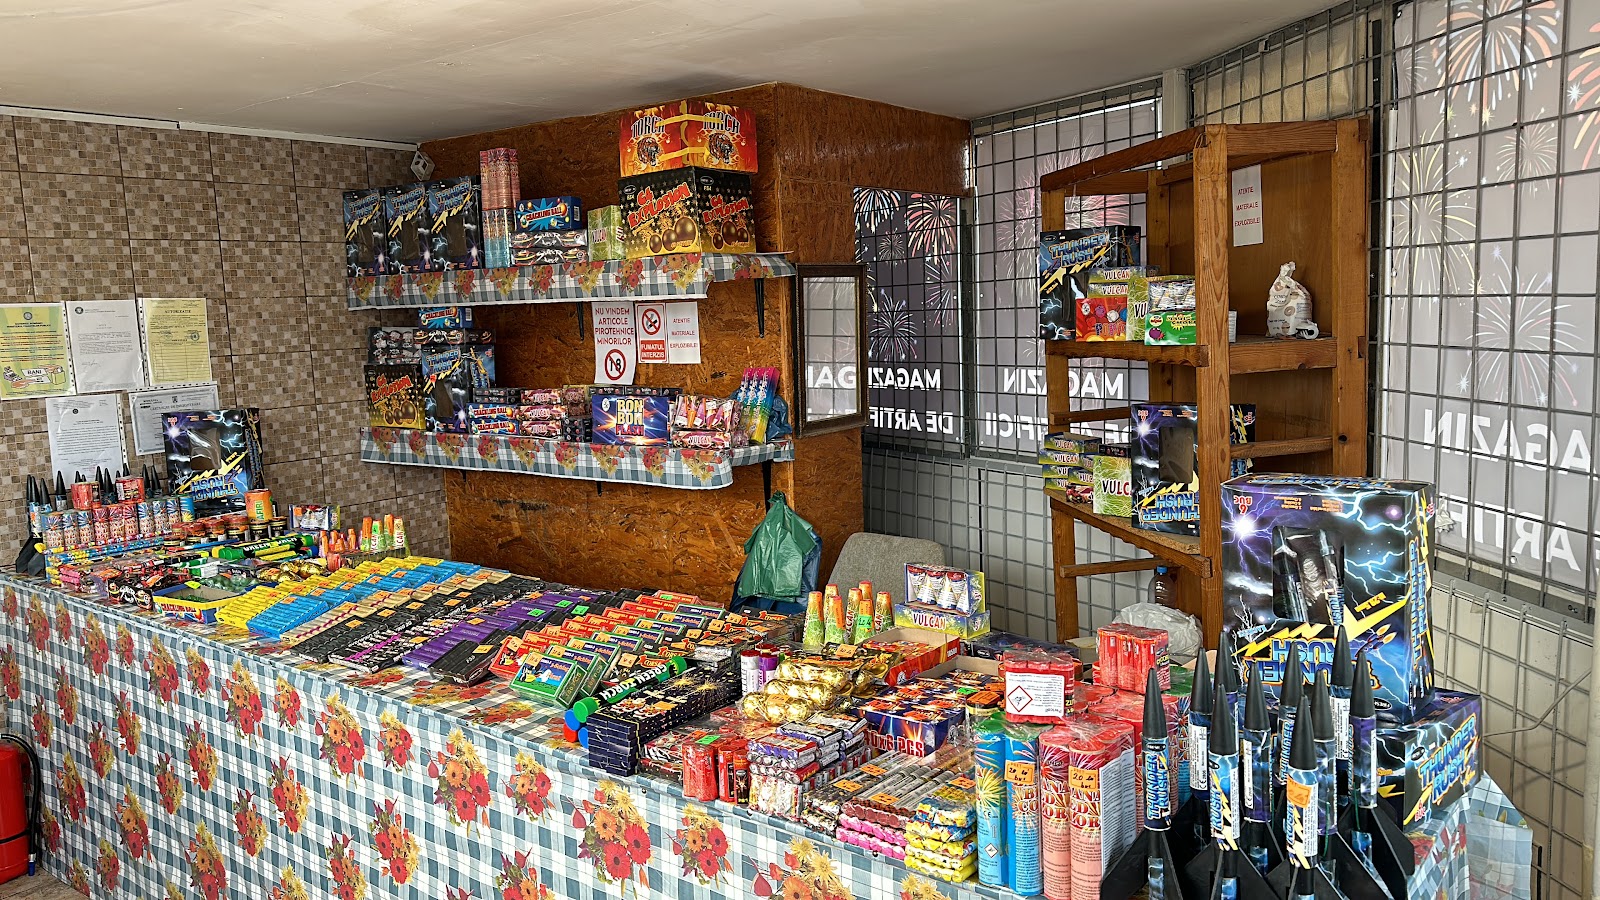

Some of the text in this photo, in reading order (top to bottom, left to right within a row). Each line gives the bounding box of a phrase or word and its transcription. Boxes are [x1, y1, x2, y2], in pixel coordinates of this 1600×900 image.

[628, 182, 692, 228] EXPLOSION
[1051, 233, 1107, 259] THUNDER
[1061, 250, 1094, 266] RUSH
[1104, 270, 1130, 280] VULCAN
[617, 399, 643, 413] BON
[617, 412, 643, 425] BON
[615, 425, 644, 436] FLASH
[1055, 440, 1074, 450] VULCAN
[1054, 454, 1079, 464] VULCAN
[191, 475, 223, 491] RUSH
[1155, 492, 1193, 507] RUSH
[1234, 496, 1252, 505] BUC
[1239, 504, 1247, 514] 6
[1409, 539, 1420, 664] THUNDER
[1418, 563, 1427, 632] RUSH
[913, 613, 946, 629] VULCAN
[599, 664, 668, 701] GREEN TORCH
[898, 736, 925, 758] PCS
[1418, 714, 1477, 788] THUNDER
[1147, 754, 1159, 819] THUNDER
[1158, 769, 1169, 808] RUSH
[1431, 753, 1466, 805] RUSH
[1211, 788, 1222, 831] RUSH
[1286, 802, 1295, 845] RUSH
